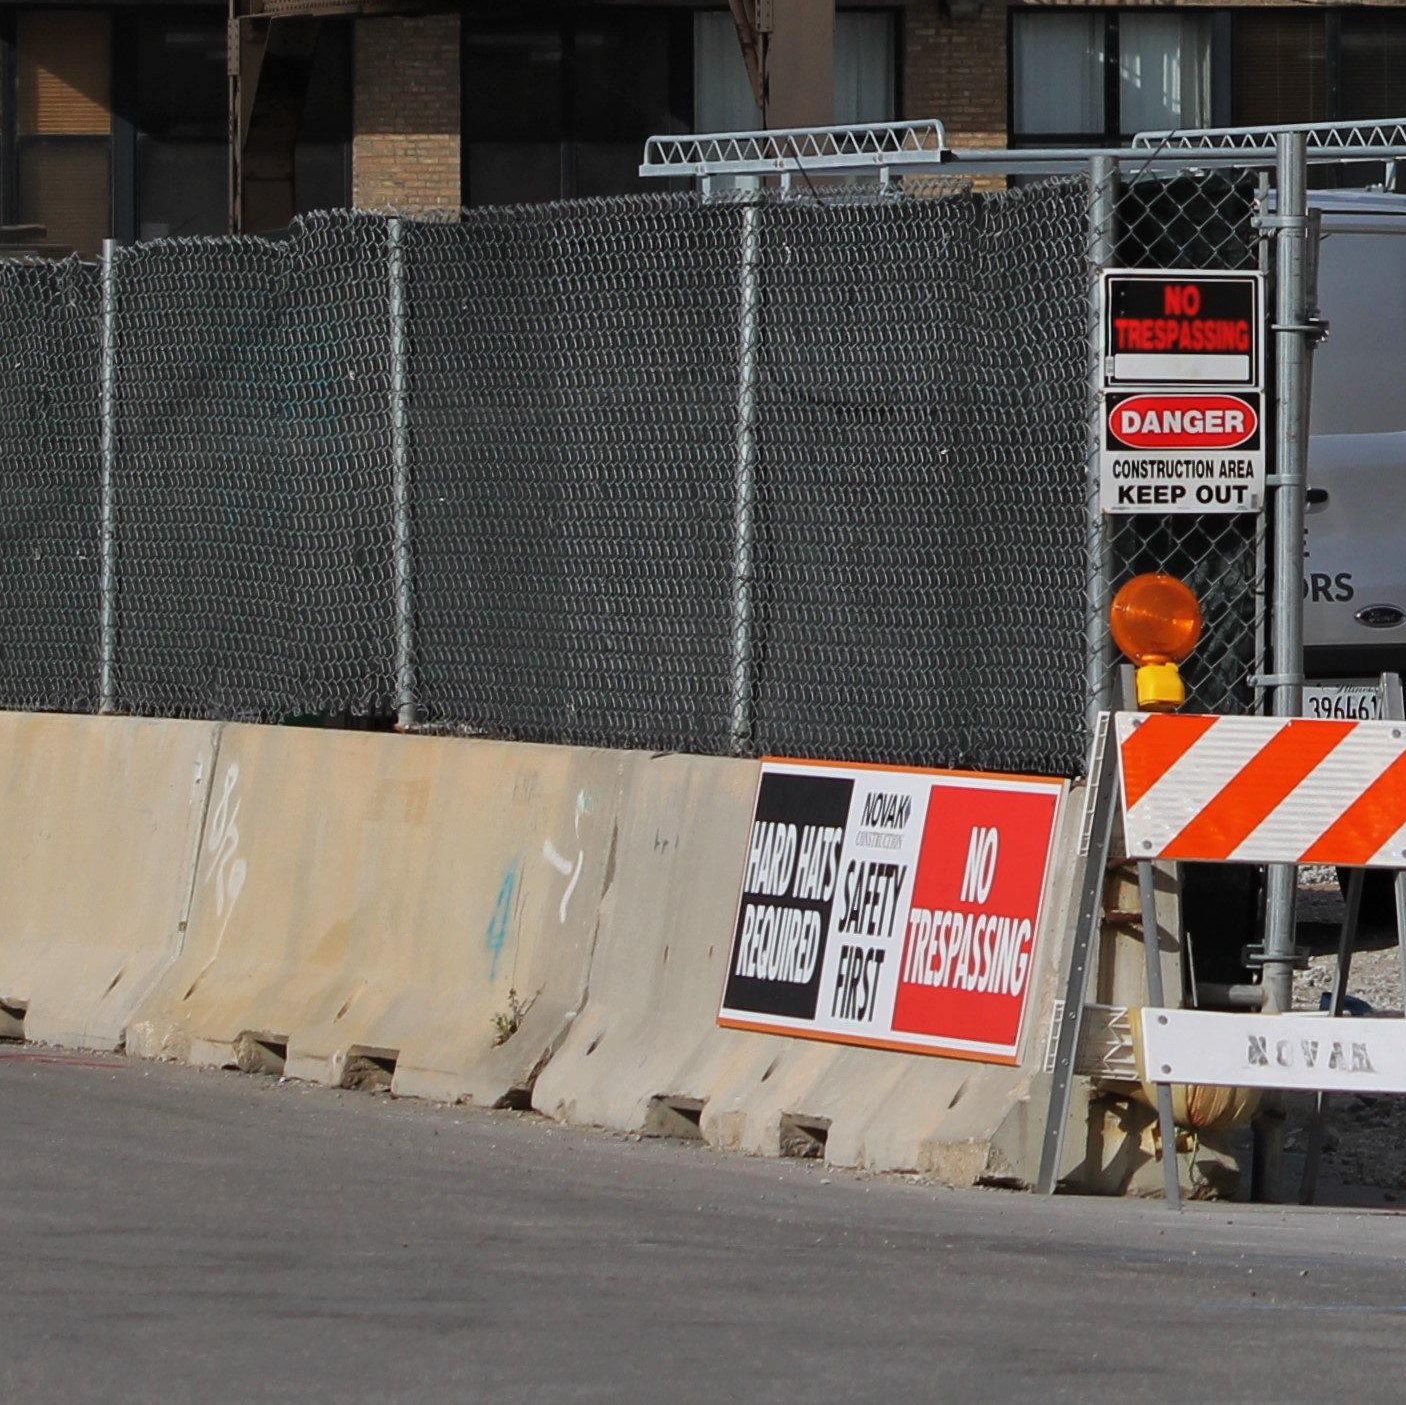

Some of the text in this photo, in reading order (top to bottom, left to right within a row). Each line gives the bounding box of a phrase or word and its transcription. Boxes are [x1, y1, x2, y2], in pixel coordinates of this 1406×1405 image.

[1163, 284, 1201, 316] NO
[1114, 318, 1249, 351] TRESPASSING
[1121, 409, 1245, 434] DANGER
[1112, 459, 1255, 479] CONSTRUCTION AREA
[1118, 484, 1249, 504] KEEP OUT
[860, 791, 911, 830] NOVAK
[744, 820, 843, 902] HARD HATS
[959, 825, 999, 905] NO
[838, 859, 908, 938] SAFETY
[735, 903, 822, 985] REQUIRED
[902, 907, 1032, 998] TRESPASSING
[831, 944, 886, 1022] FIRST
